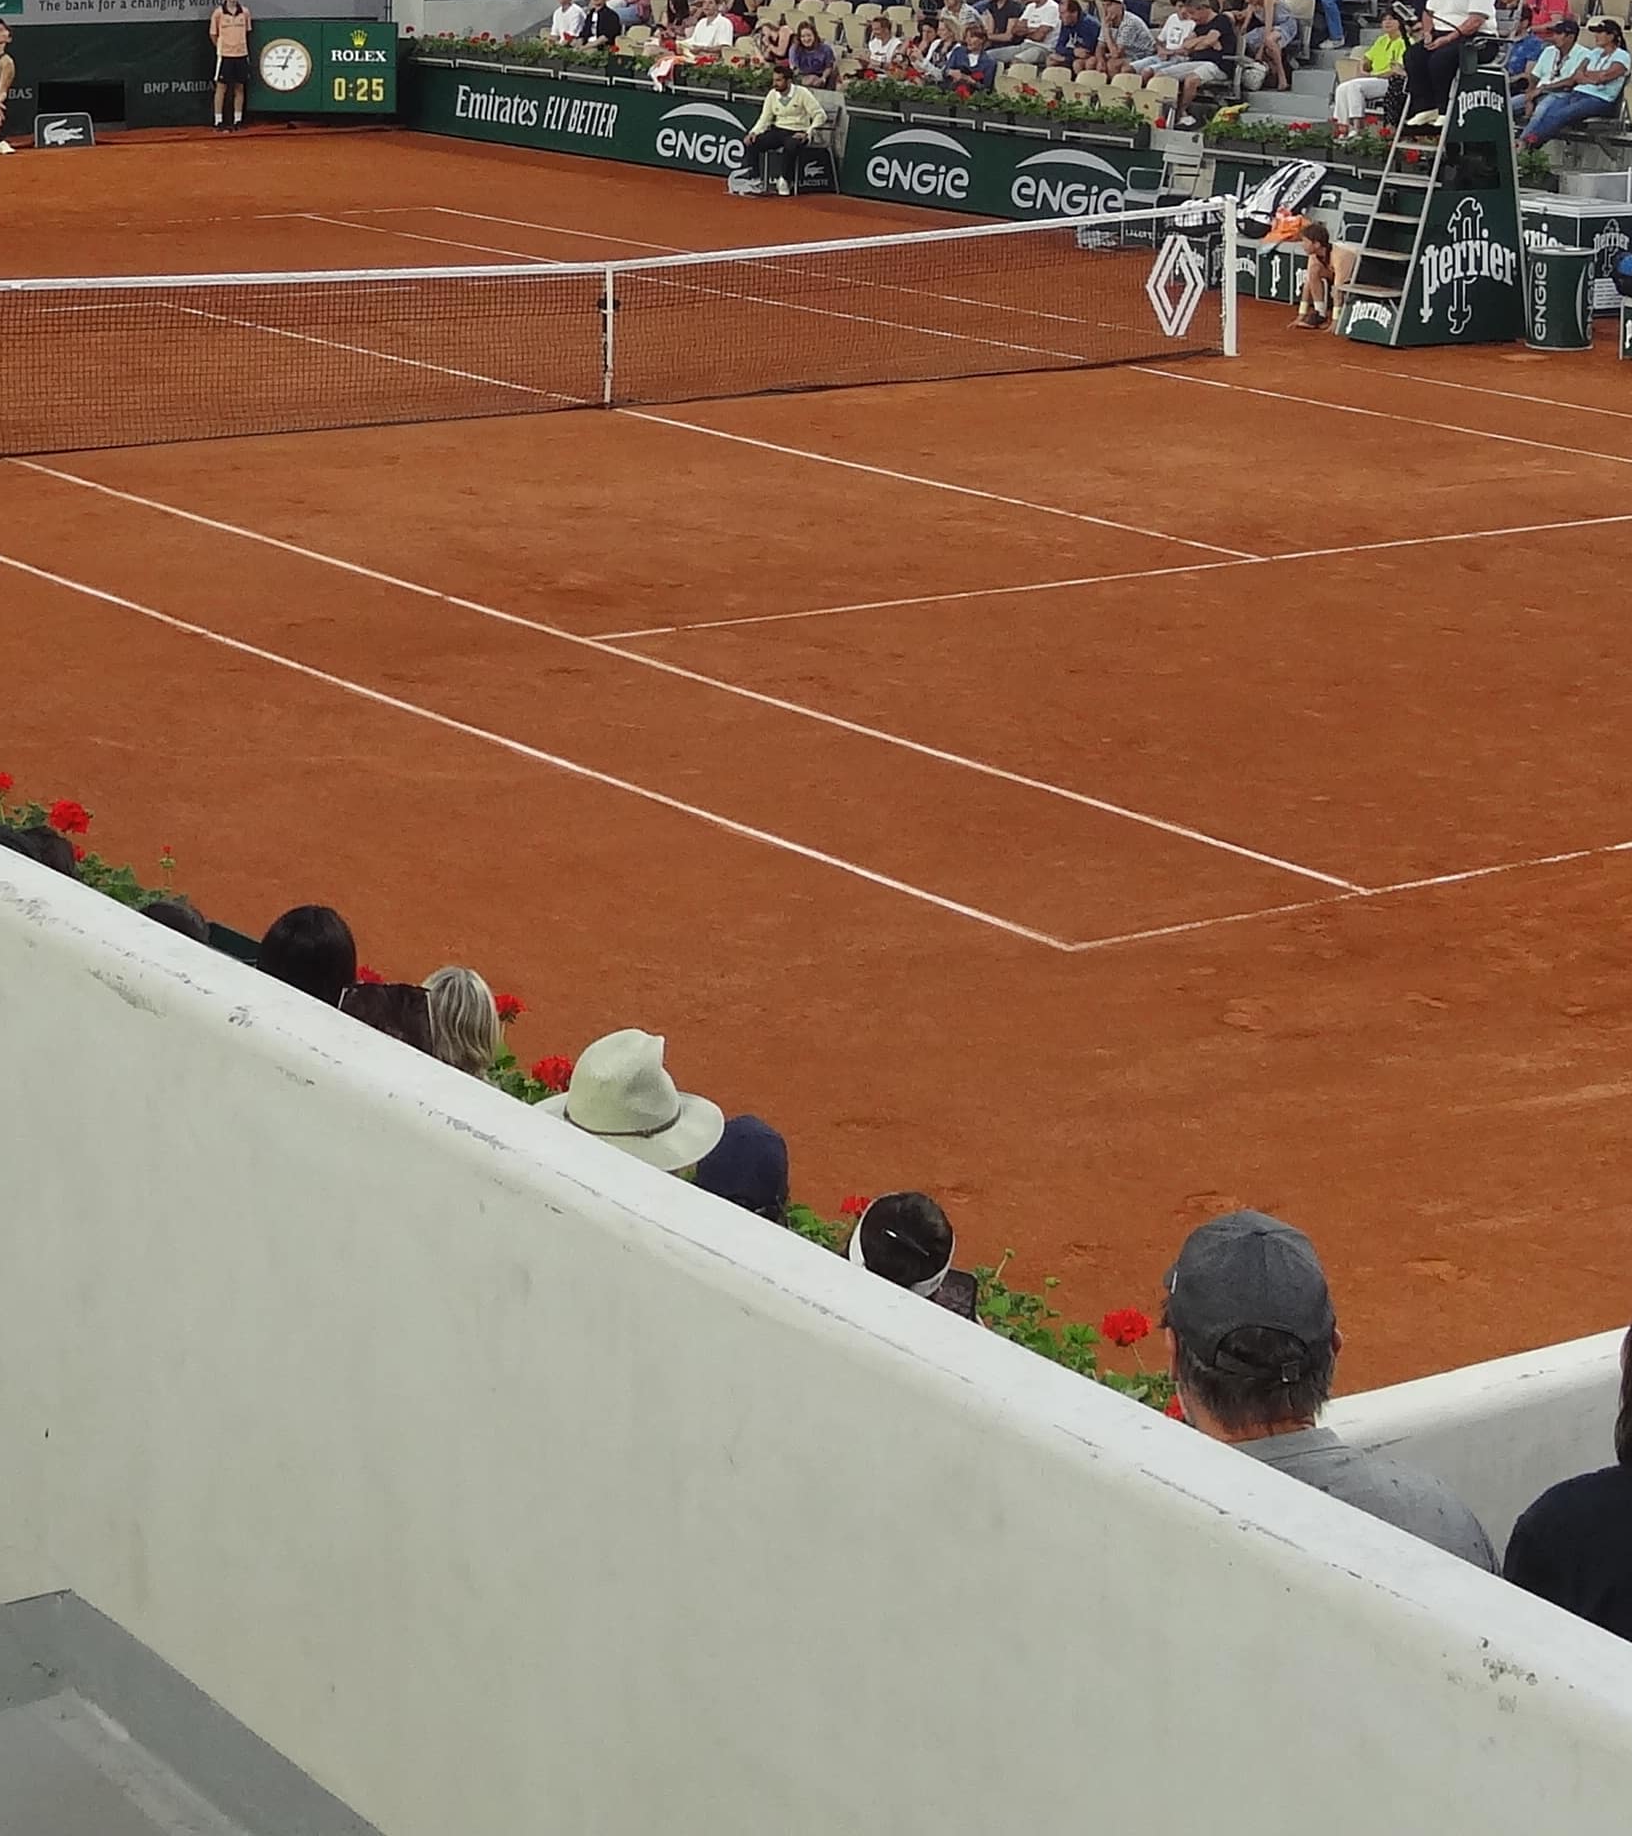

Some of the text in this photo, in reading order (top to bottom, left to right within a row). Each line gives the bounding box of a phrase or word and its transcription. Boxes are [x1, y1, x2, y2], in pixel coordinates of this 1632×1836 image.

[39, 1, 60, 11] The
[66, 0, 94, 11] bank
[98, 0, 116, 12] for
[120, 1, 127, 9] a
[331, 49, 387, 62] ROLEX
[143, 81, 214, 94] BNP PARIBA
[334, 78, 384, 101] 0:25
[455, 85, 618, 138] Emirates FLY BETTER
